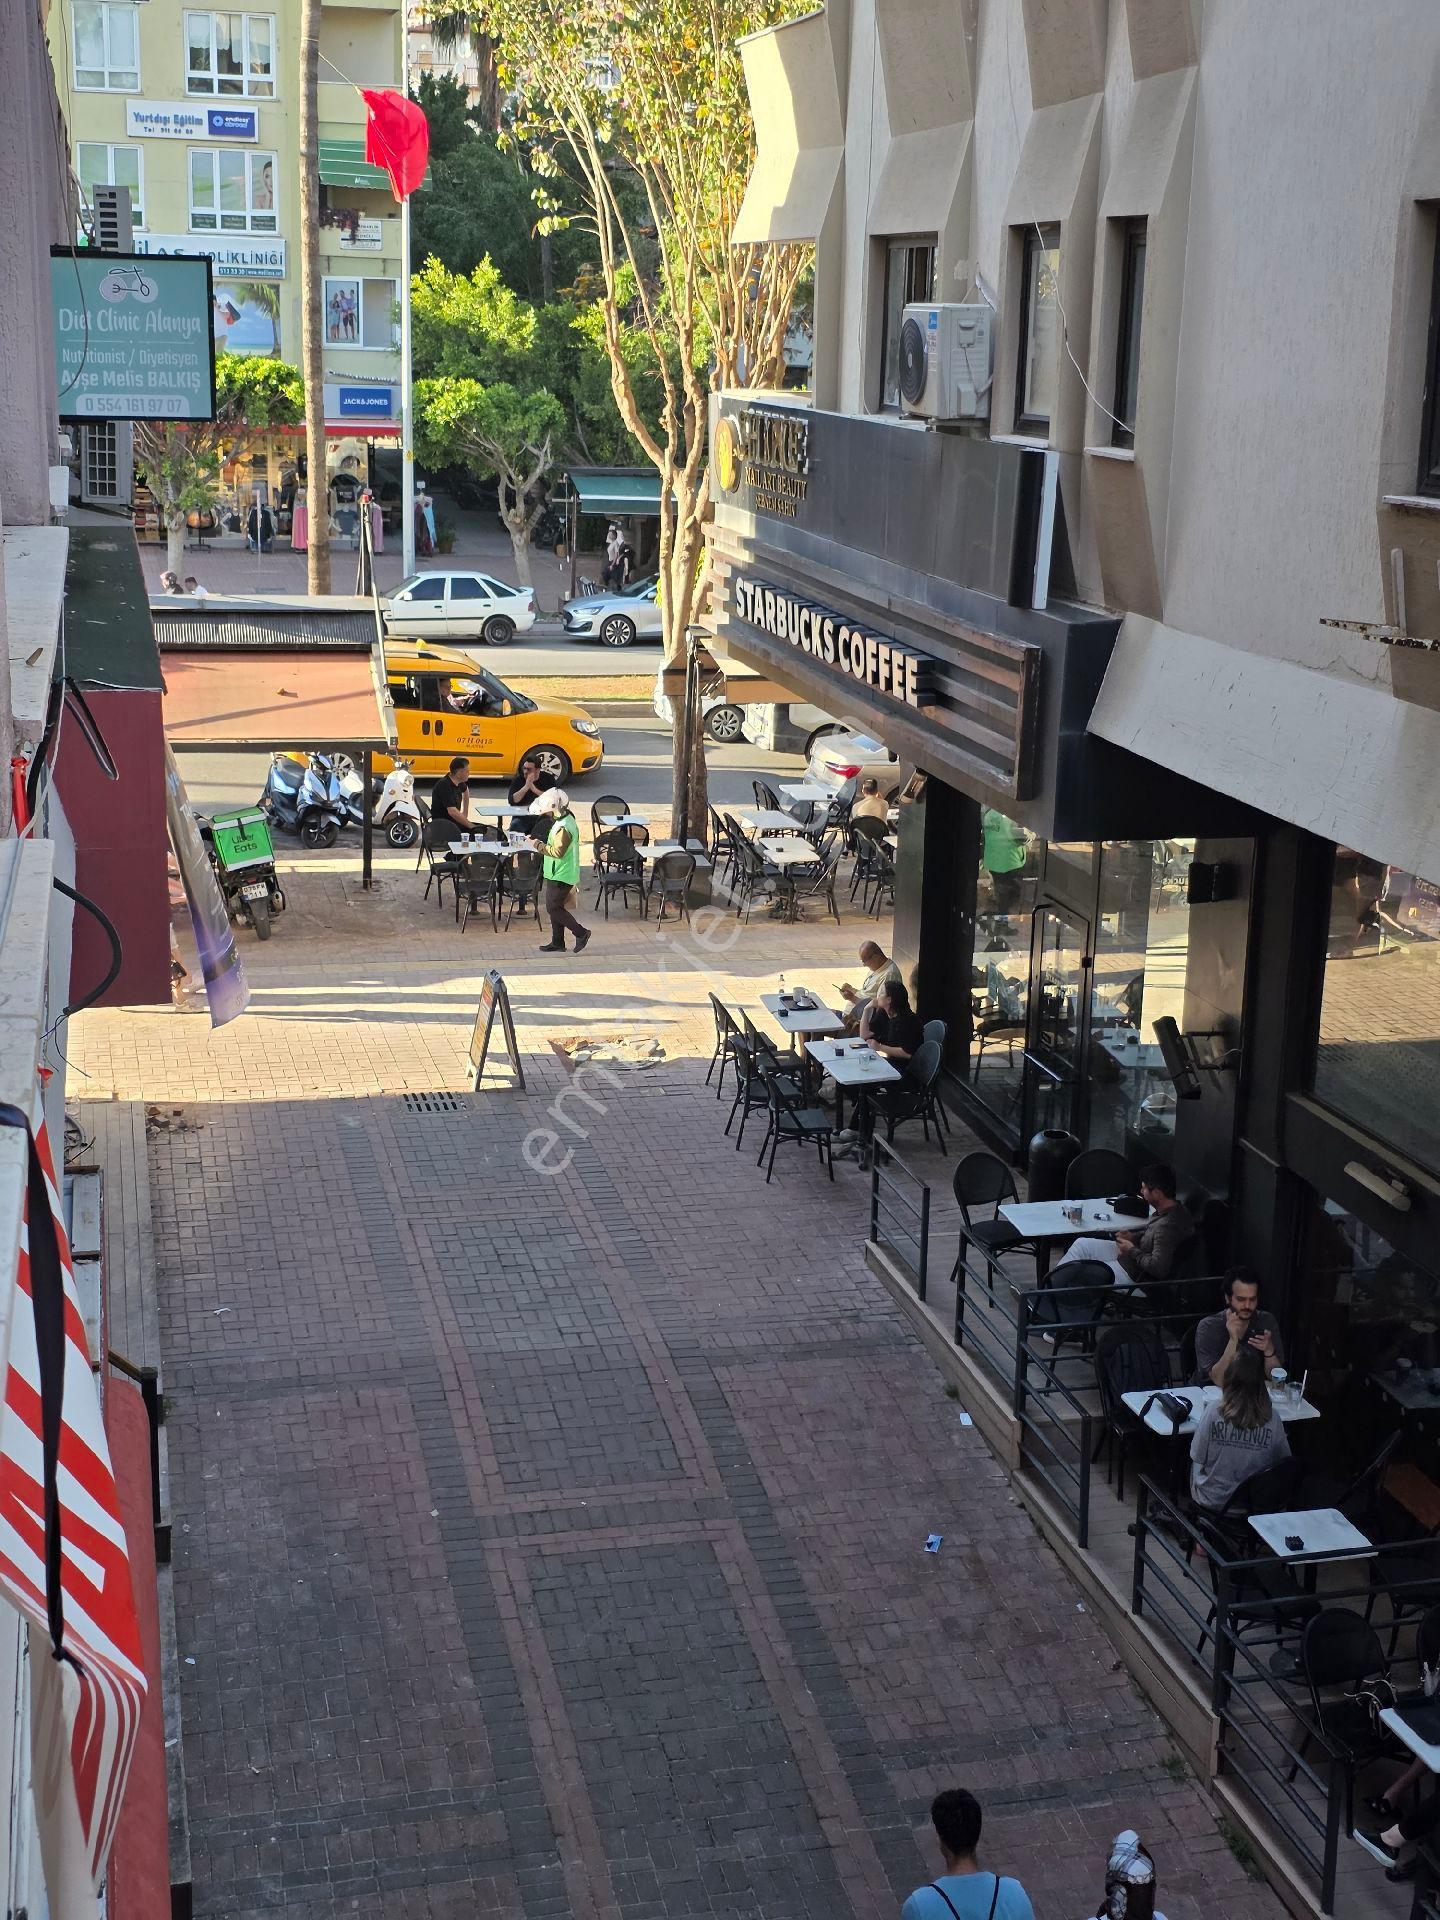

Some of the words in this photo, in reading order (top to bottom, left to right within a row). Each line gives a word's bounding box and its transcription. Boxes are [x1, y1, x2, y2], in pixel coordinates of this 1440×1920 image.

[96, 307, 141, 332] Clinic
[145, 307, 202, 340] Alanya
[62, 347, 126, 364] Nutritionist
[139, 350, 199, 368] Diyetisyen
[61, 369, 99, 392] Ayşe
[102, 369, 144, 388] Melis
[147, 371, 201, 394] BALKIŞ
[85, 397, 93, 412] 0
[96, 398, 122, 412] 554
[149, 398, 162, 412] 97
[167, 399, 182, 412] 07
[343, 398, 388, 406] JACK&JONES
[744, 466, 762, 488] NAIL
[762, 471, 777, 493] ART
[777, 474, 807, 500] BEAUTY
[735, 576, 835, 665] STARBUCKS
[838, 625, 920, 708] COFFEE
[234, 842, 258, 854] Eats
